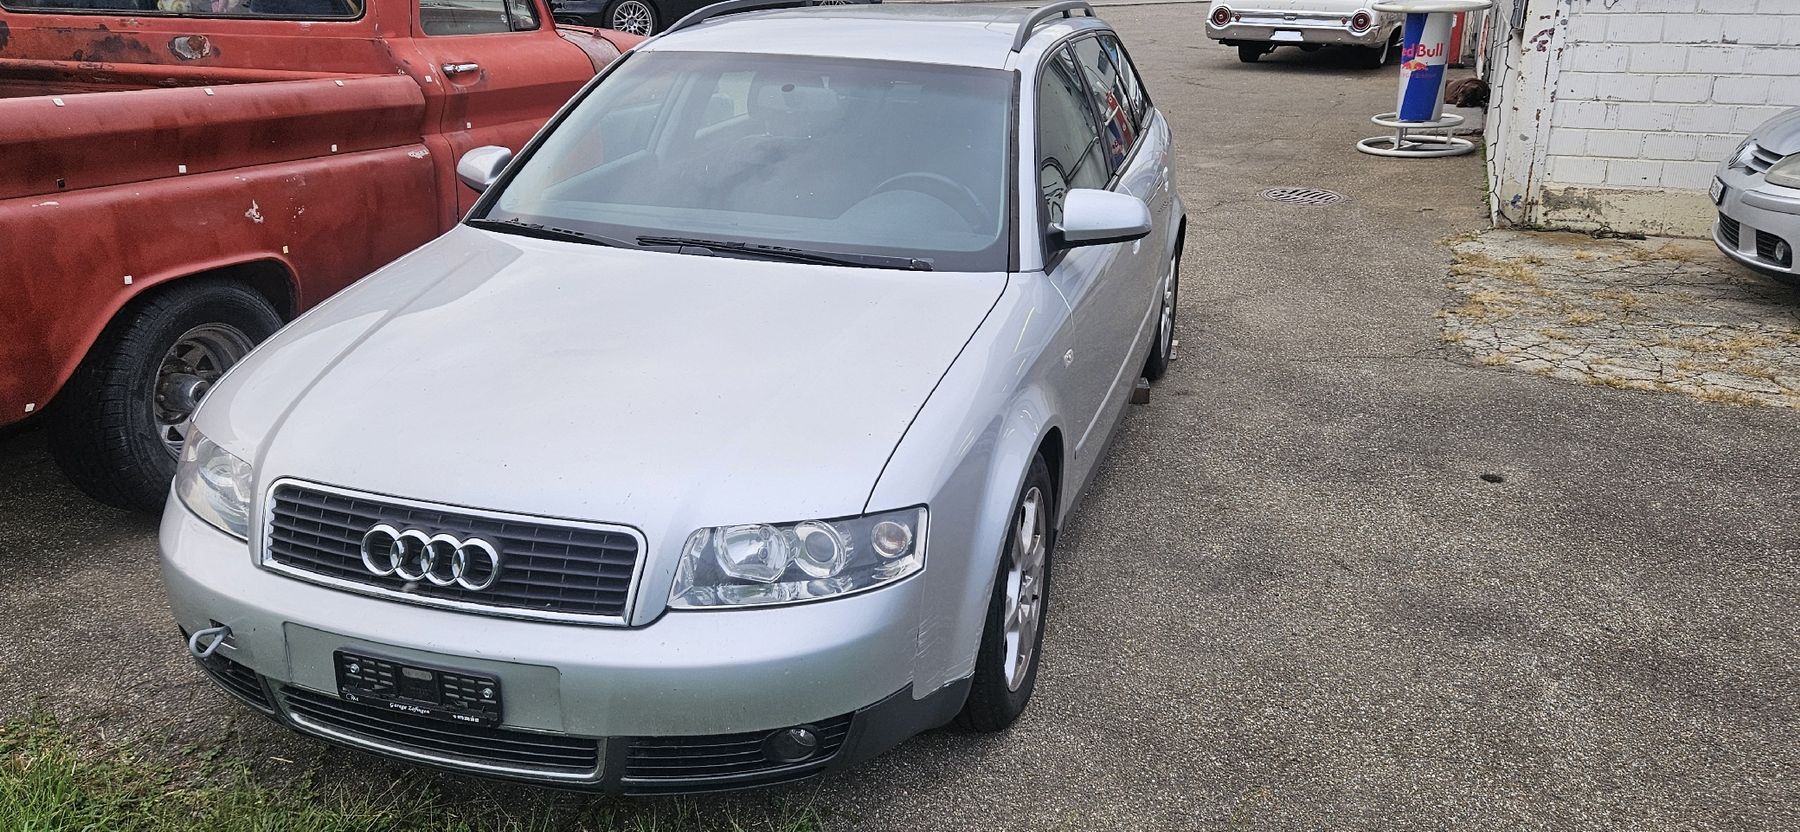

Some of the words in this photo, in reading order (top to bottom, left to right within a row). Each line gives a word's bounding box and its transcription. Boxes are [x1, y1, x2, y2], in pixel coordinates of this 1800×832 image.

[1402, 43, 1415, 56] ed
[1417, 43, 1443, 57] Bull
[389, 703, 407, 711] Garage
